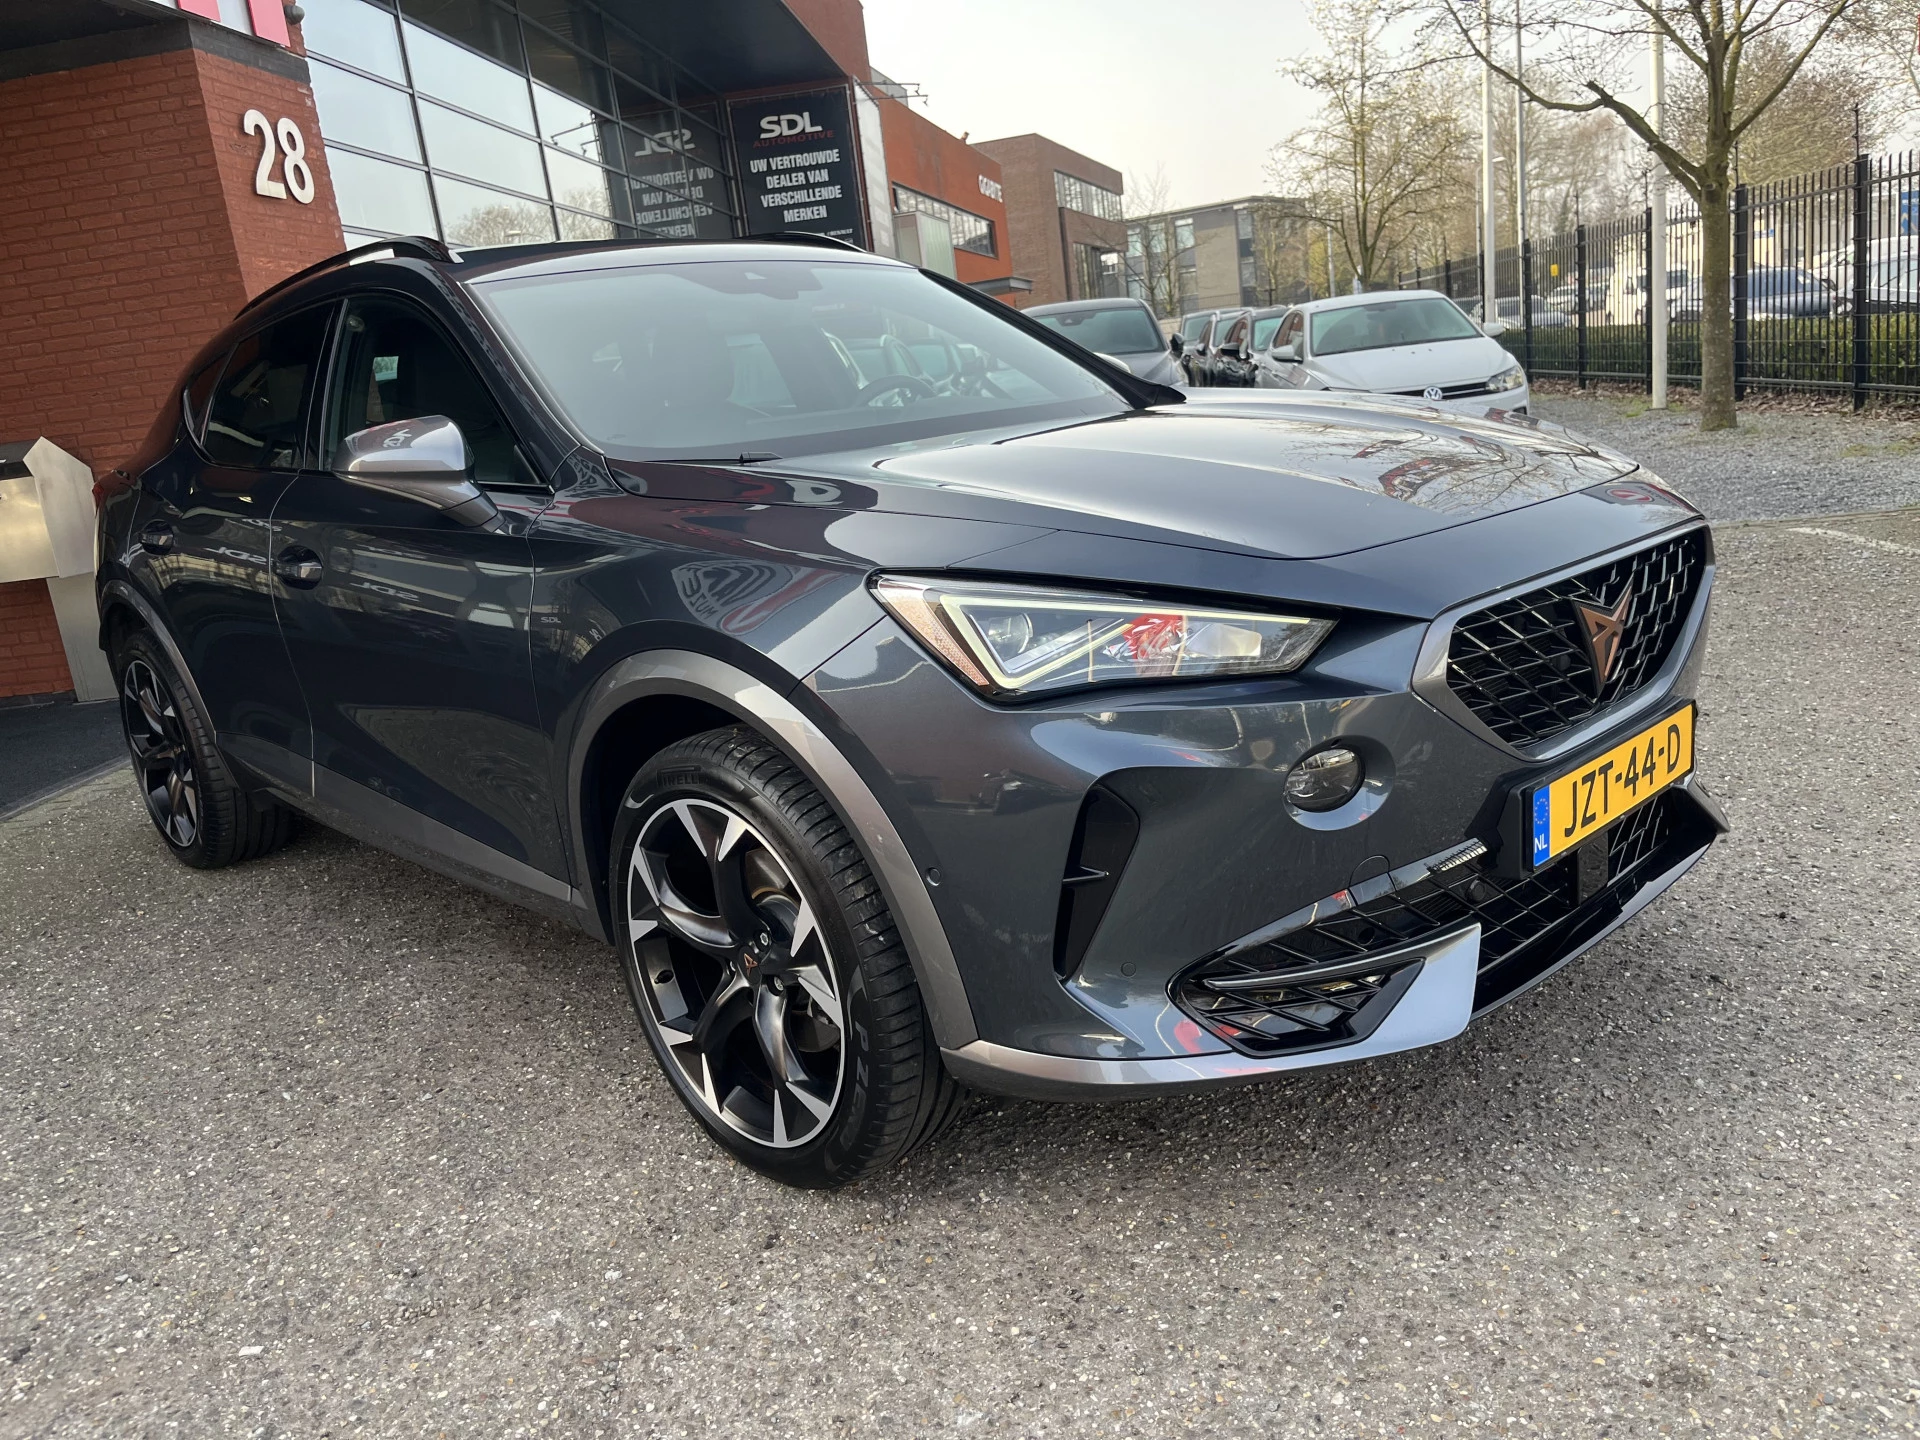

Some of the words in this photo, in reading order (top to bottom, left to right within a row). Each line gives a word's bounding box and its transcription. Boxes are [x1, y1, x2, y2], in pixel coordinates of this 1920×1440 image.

[760, 112, 823, 139] SDL
[752, 129, 835, 149] AUTOMOTIVE
[243, 109, 315, 205] 28
[749, 159, 768, 174] UW
[769, 149, 841, 171] VERTROUWDE
[766, 173, 806, 190] DEALER
[807, 169, 829, 184] VAN
[760, 185, 843, 208] VERSCHILLENDE
[783, 205, 828, 223] MERKEN
[1564, 723, 1681, 838] JZT-44-D
[1534, 833, 1548, 854] NL
